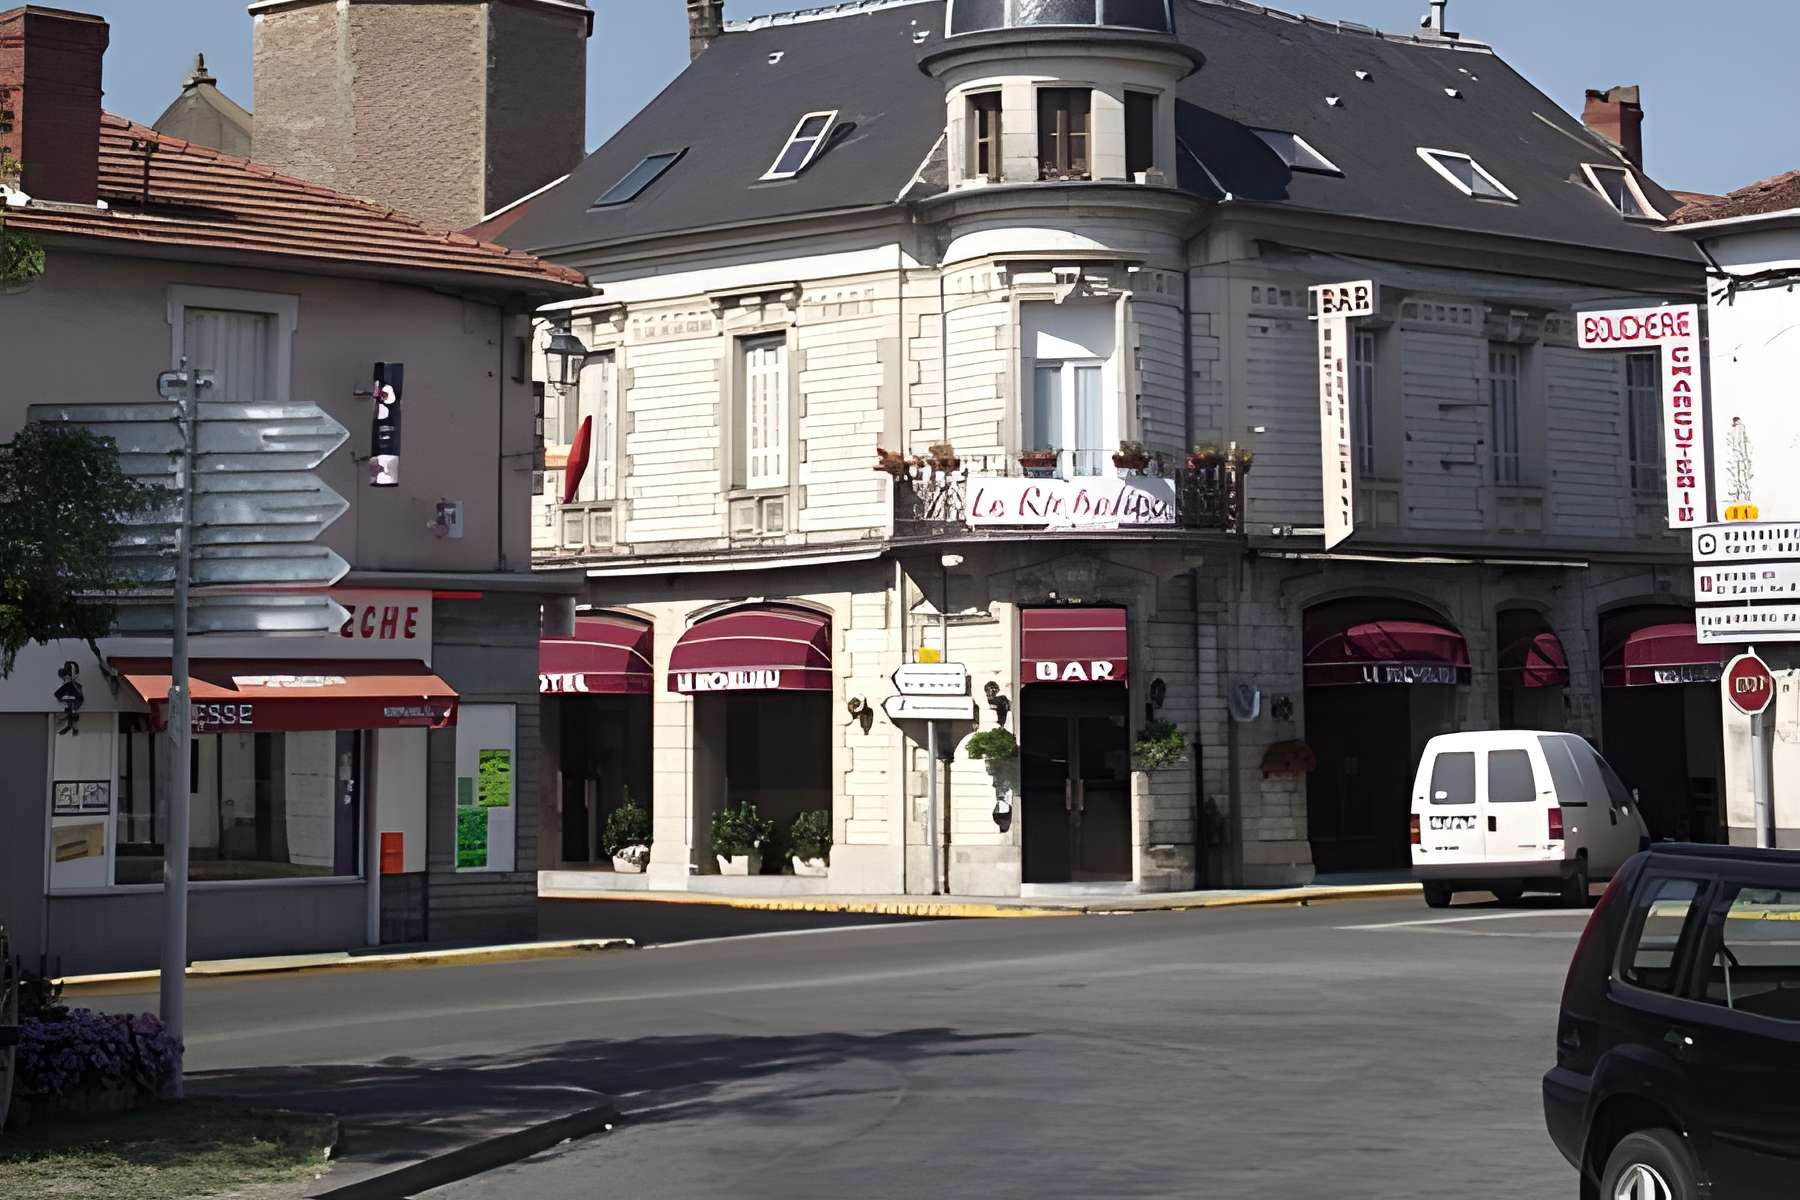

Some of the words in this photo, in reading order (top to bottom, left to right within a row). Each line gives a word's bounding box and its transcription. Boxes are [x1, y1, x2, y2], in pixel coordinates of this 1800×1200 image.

[1321, 286, 1370, 314] BAR
[1035, 660, 1114, 681] BAR
[190, 704, 253, 725] ESSE
